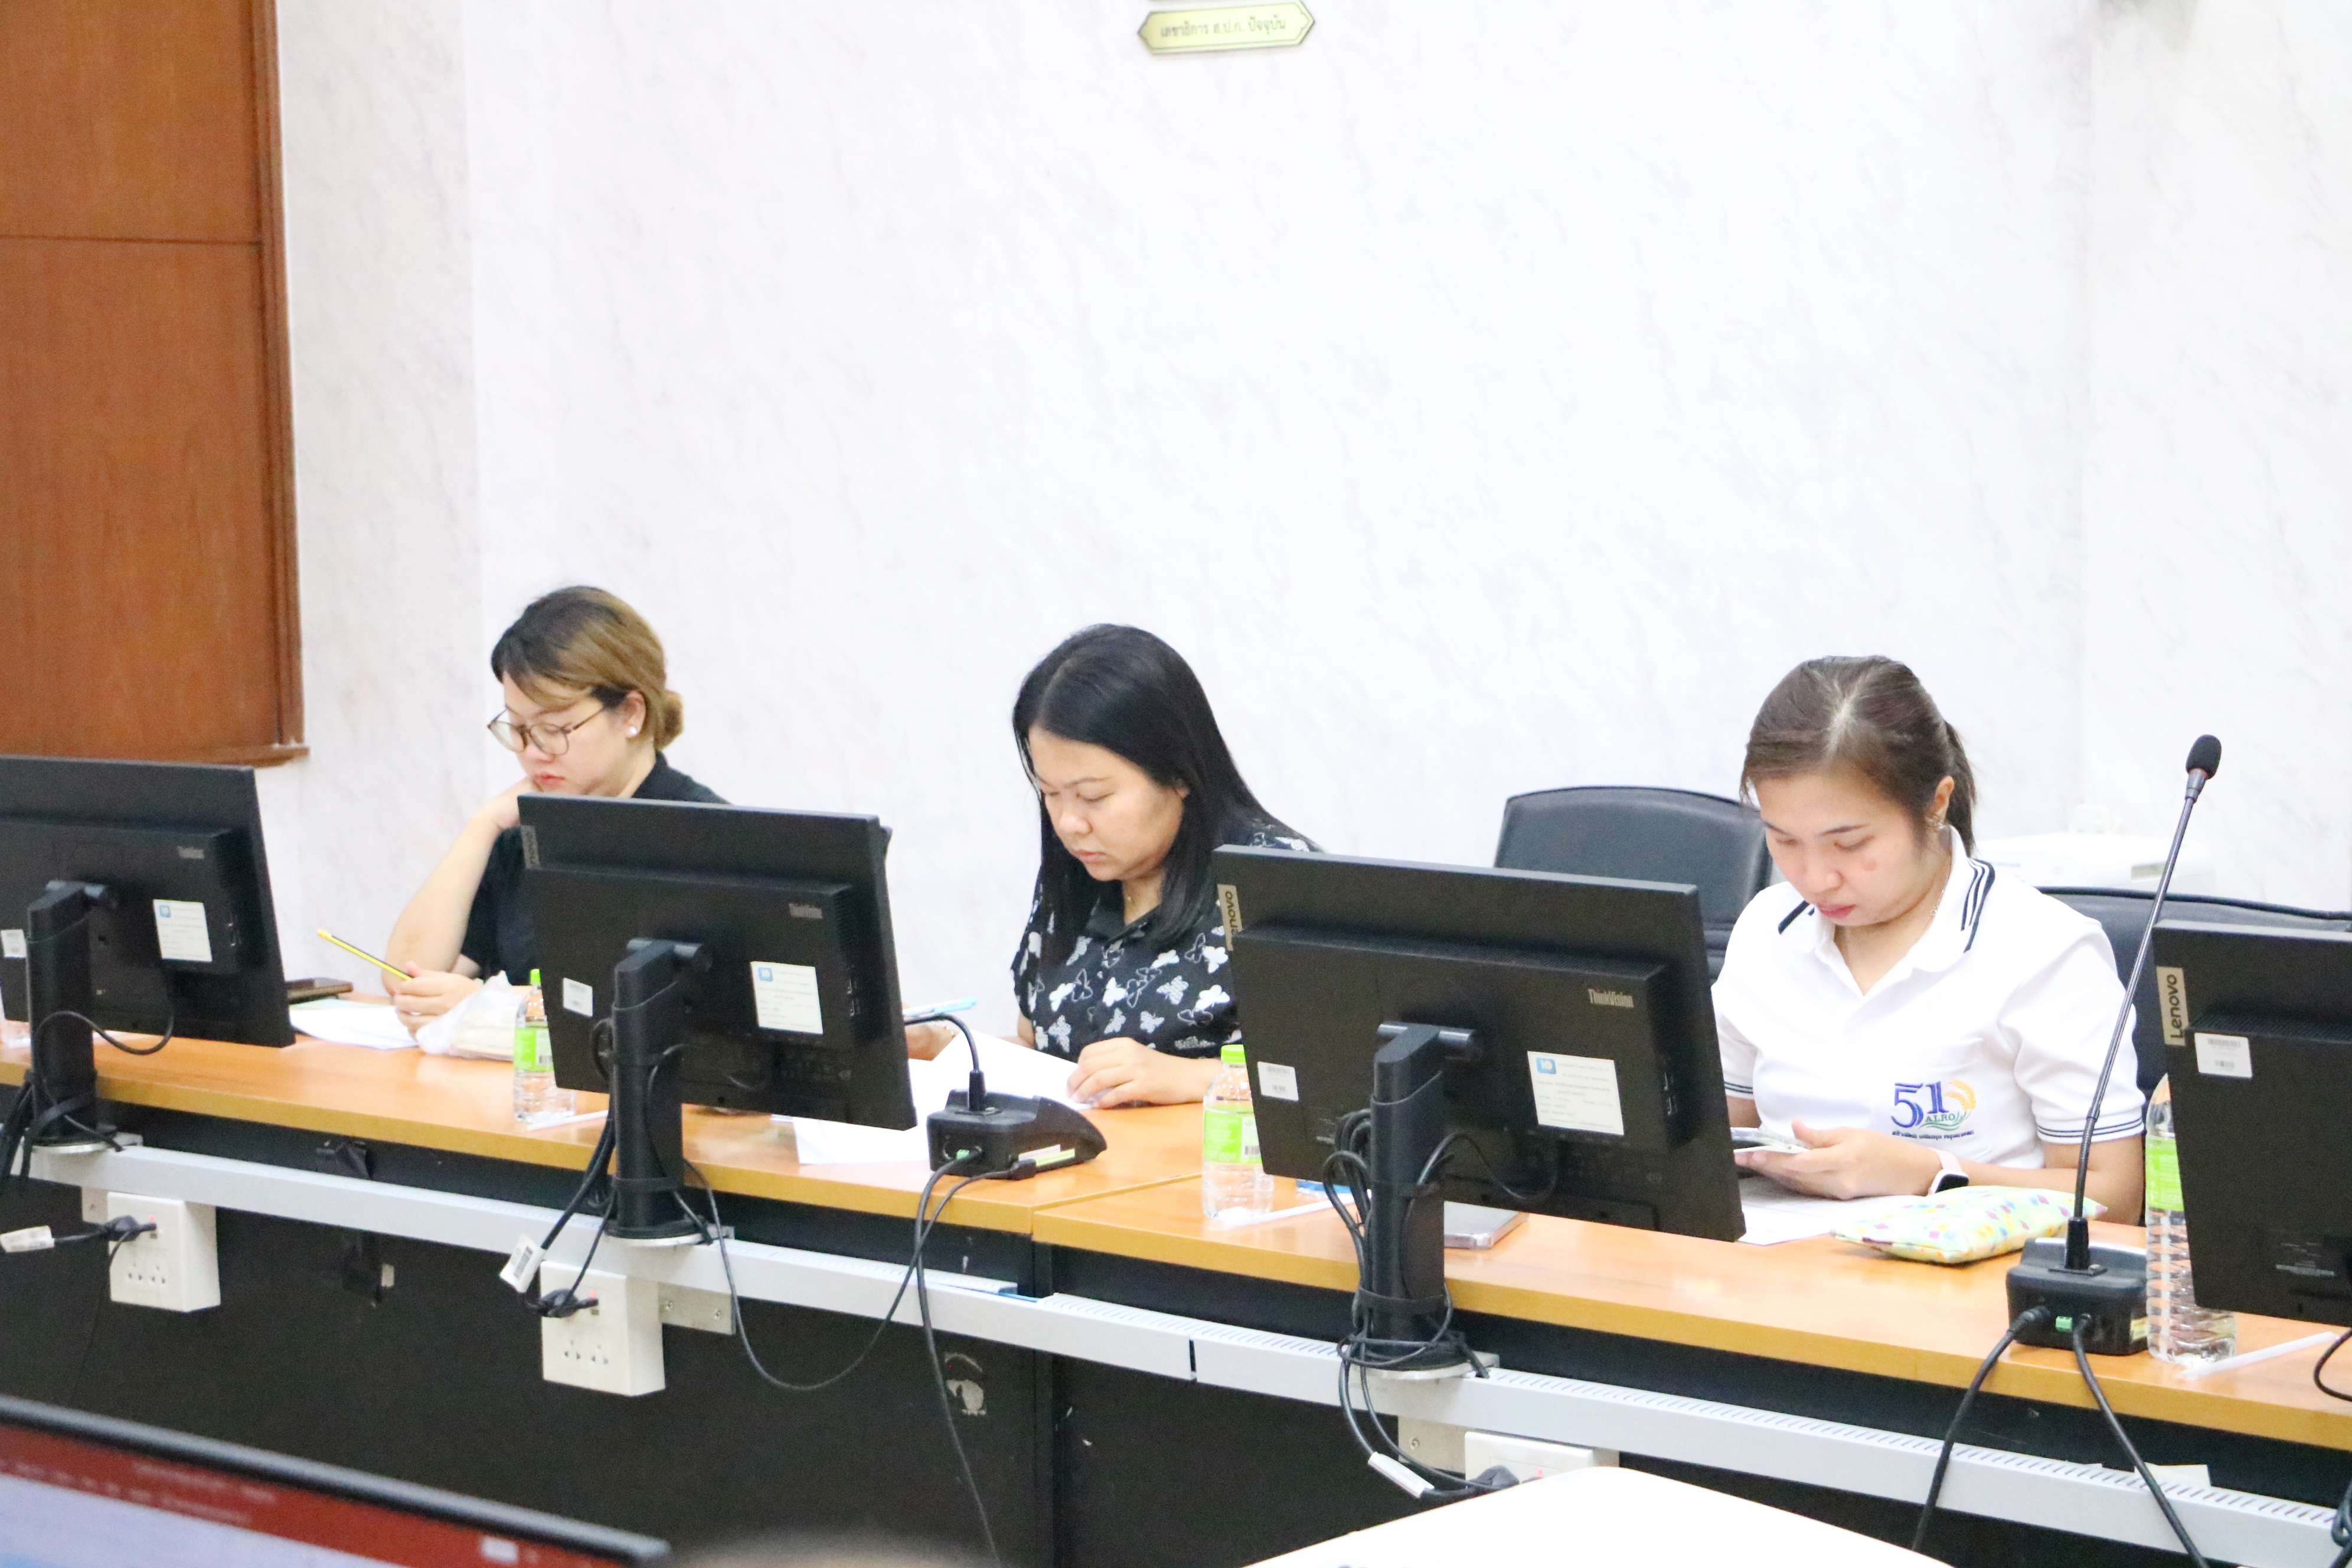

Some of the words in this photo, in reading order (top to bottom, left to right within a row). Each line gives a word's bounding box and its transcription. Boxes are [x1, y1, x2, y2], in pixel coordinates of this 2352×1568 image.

[1249, 14, 1286, 35] ปัจจุบัน
[1225, 890, 1239, 936] enovo
[2166, 974, 2185, 1039] Lenovo
[1891, 1081, 1949, 1128] 51
[1924, 1113, 1956, 1123] ALRO
